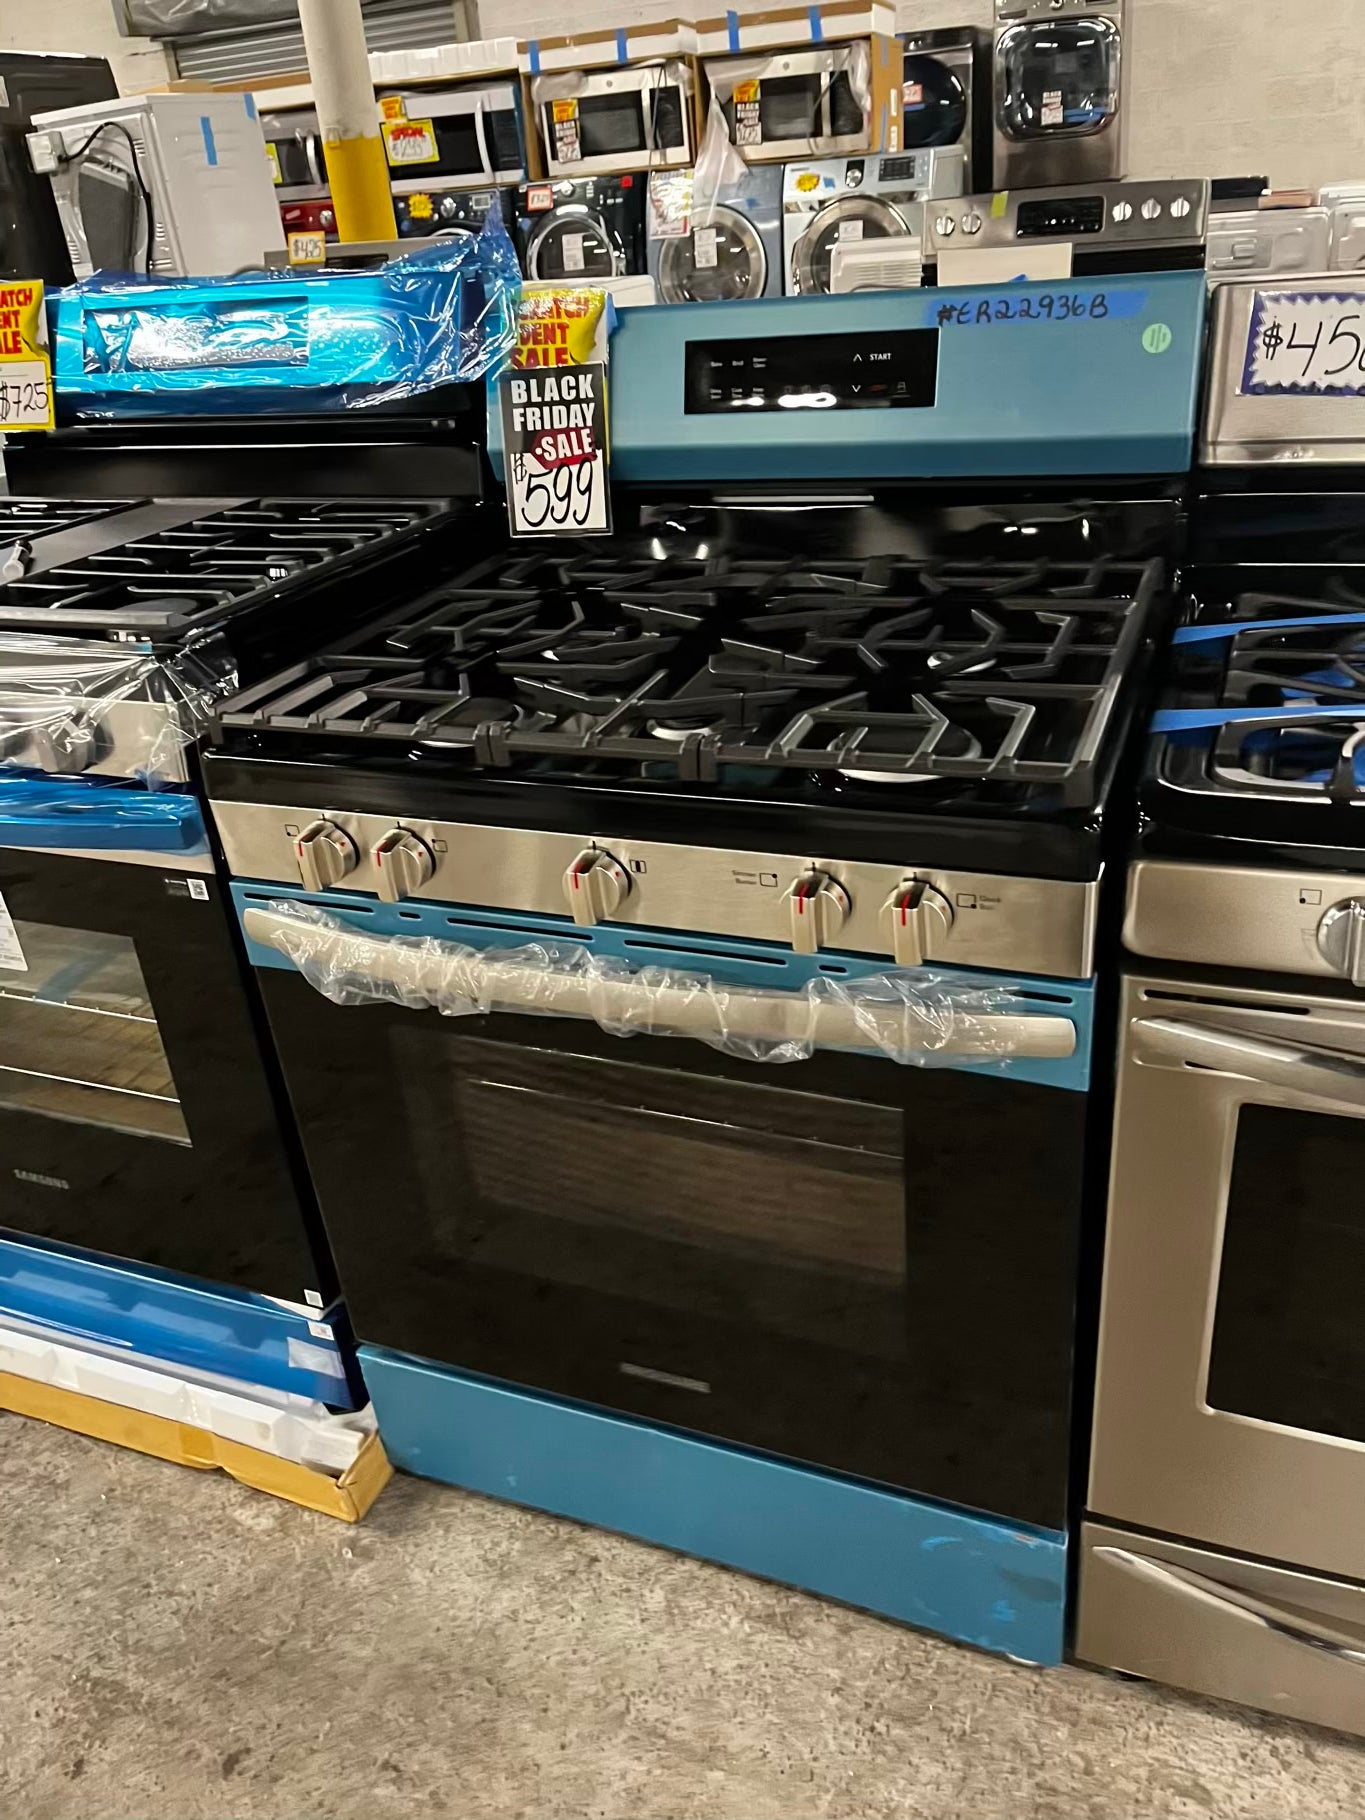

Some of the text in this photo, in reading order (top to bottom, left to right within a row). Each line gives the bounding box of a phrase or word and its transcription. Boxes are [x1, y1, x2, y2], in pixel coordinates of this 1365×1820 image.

[0, 330, 23, 354] LE
[869, 352, 893, 362] START
[1262, 314, 1365, 376] $45
[510, 346, 570, 369] SALE
[510, 373, 595, 404] BLACK
[511, 402, 596, 432] FRIDAY
[540, 428, 594, 462] SALE
